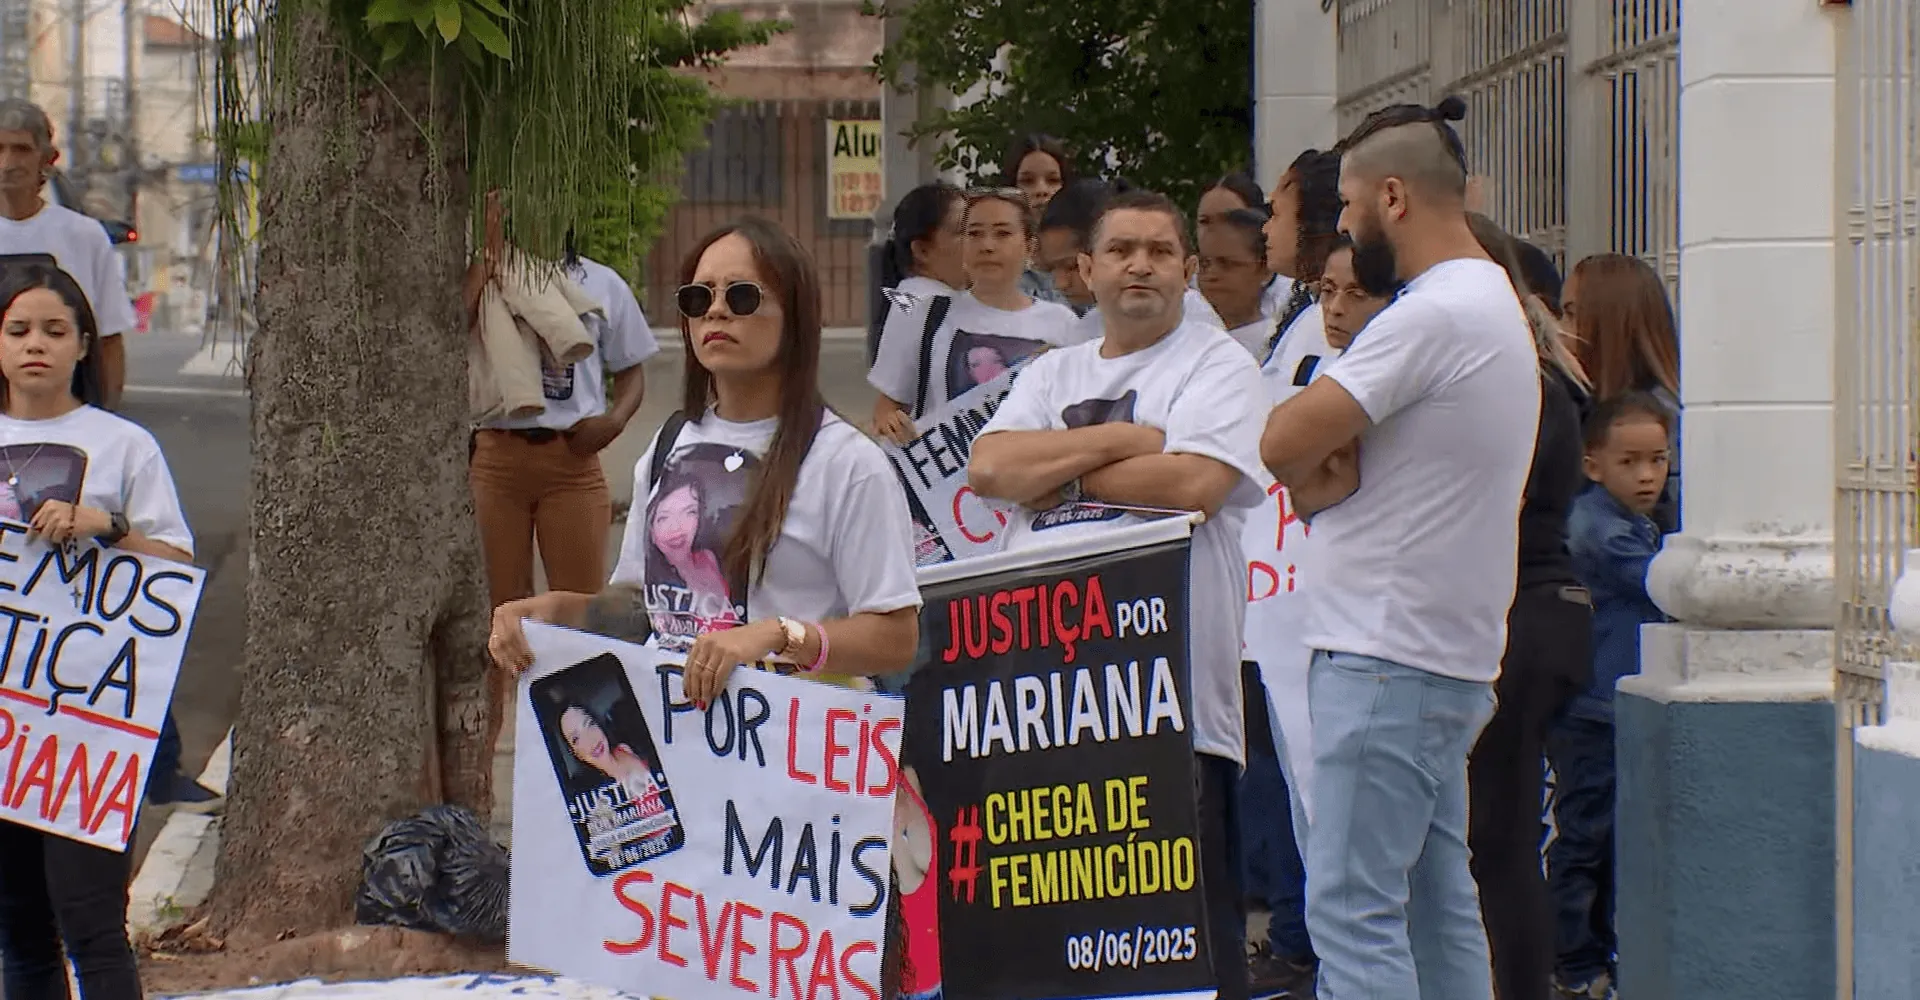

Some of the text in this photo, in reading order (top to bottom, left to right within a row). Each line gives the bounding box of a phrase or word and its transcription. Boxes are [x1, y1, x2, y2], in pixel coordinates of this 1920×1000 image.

[834, 124, 882, 157] Alu
[942, 575, 1169, 664] JUSTIÇA POR
[655, 663, 771, 767] POR
[942, 656, 1185, 762] MARIANA
[985, 775, 1151, 845] CHEGA DE
[989, 831, 1196, 909] FEMINICÍDIO
[603, 870, 882, 1000] SEVERAS
[1066, 925, 1198, 973] 08/06/2025
